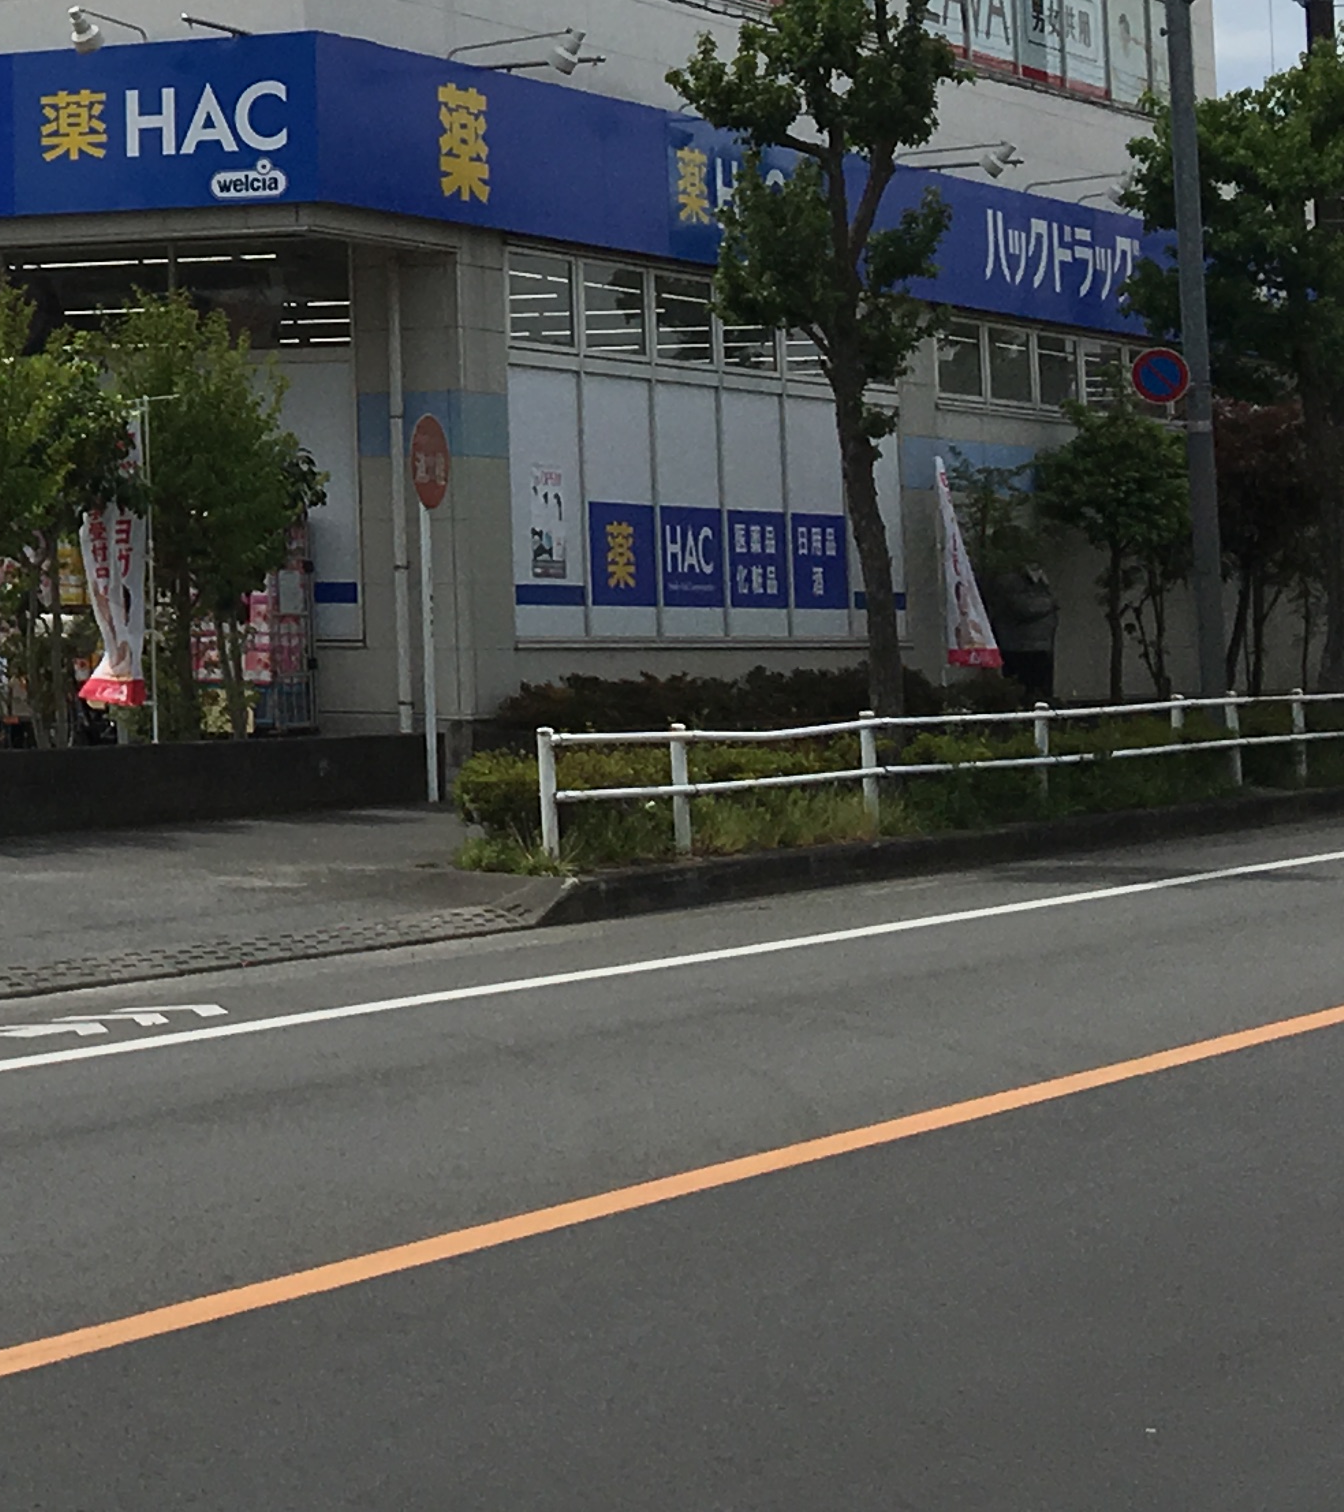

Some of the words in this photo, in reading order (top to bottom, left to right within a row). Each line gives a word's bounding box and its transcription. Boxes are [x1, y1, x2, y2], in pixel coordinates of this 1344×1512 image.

[39, 89, 108, 162] 薬
[125, 79, 288, 158] HAC
[437, 82, 491, 204] 薬
[216, 173, 279, 193] welcia
[675, 146, 710, 225] 薬
[985, 208, 1141, 303] ハックドラッグ
[605, 521, 636, 589] 薬
[665, 524, 714, 575] HAC
